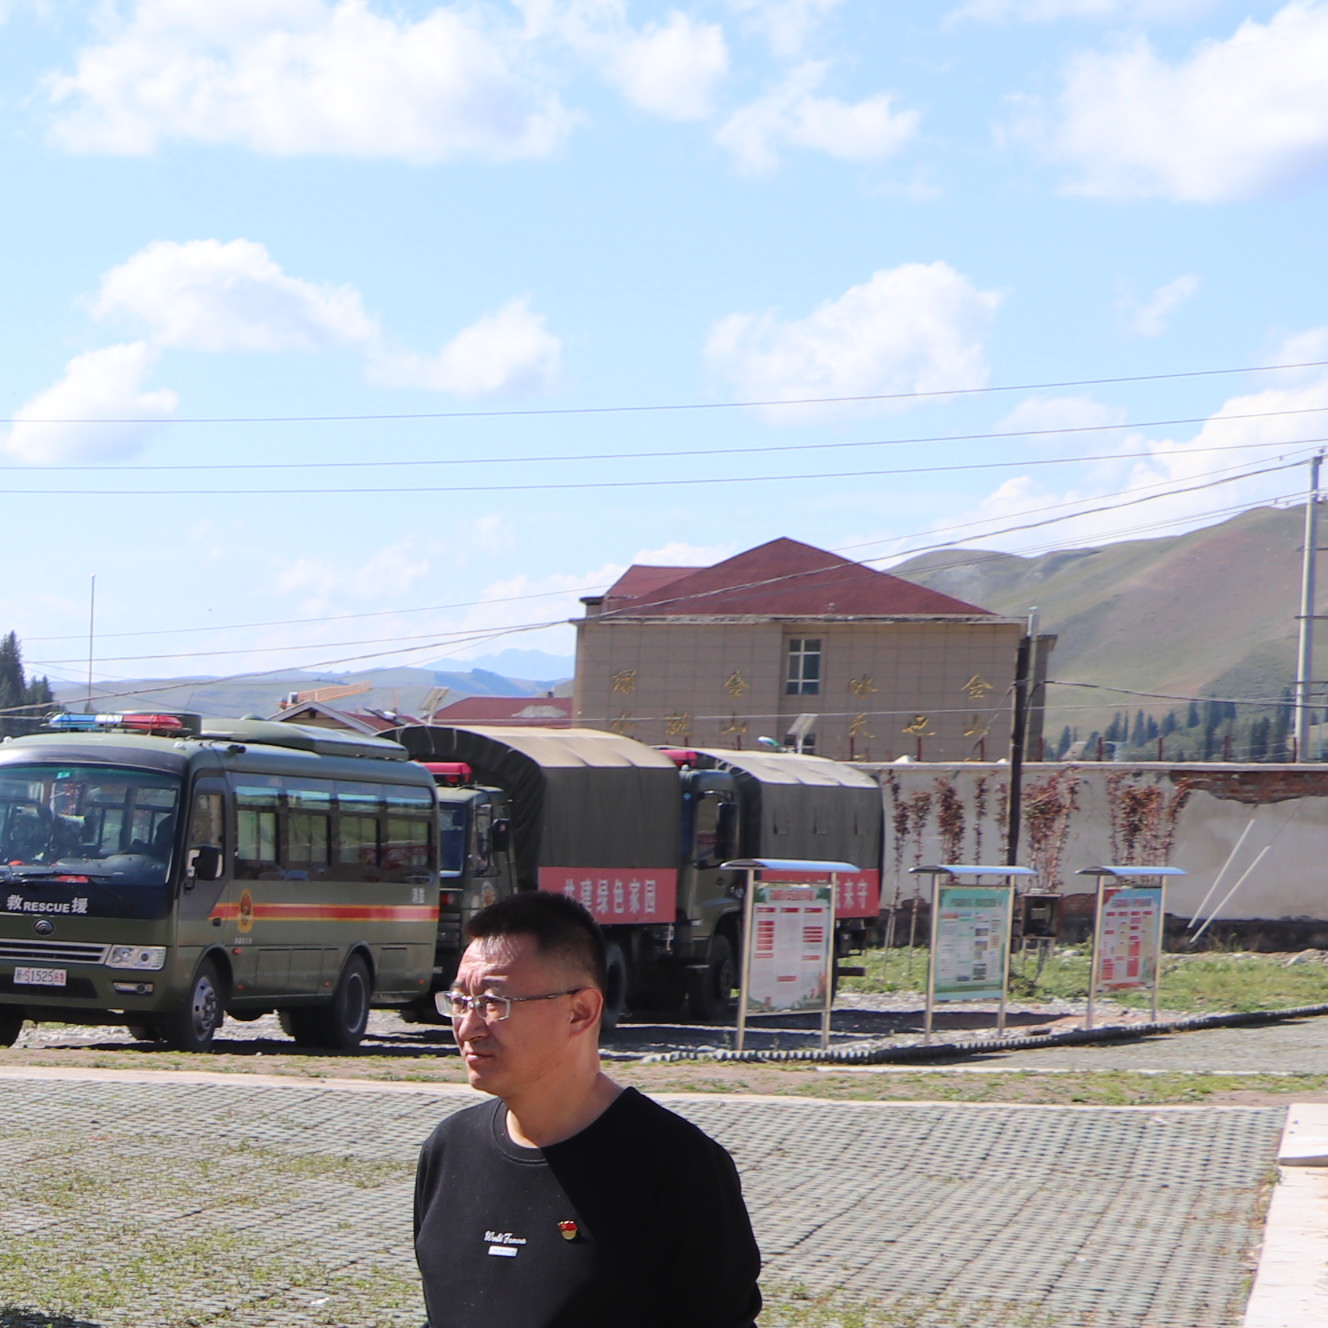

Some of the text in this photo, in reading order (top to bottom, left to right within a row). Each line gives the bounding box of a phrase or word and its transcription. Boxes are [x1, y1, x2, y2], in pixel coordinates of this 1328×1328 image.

[6, 894, 88, 914] 救 RESCUE 援
